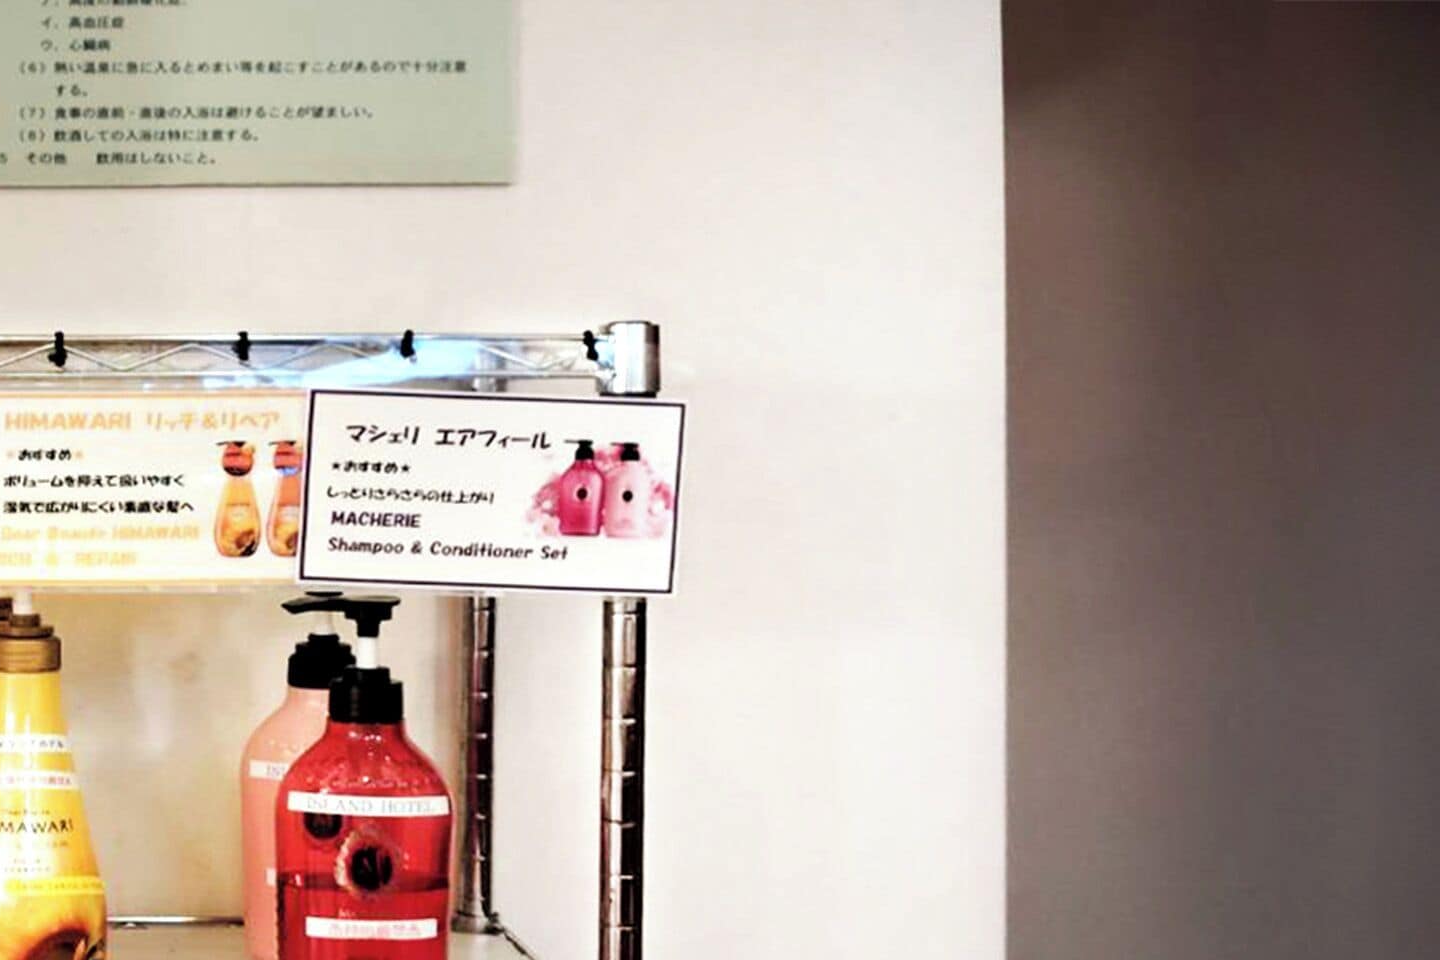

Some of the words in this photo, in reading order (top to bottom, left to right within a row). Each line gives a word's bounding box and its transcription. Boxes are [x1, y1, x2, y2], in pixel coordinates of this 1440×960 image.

[4, 411, 132, 432] HIMAWARI
[346, 424, 421, 446] マシェリ
[434, 427, 552, 450] エアフィール
[330, 510, 423, 529] MACHERIE
[327, 537, 404, 555] Shampoo
[410, 540, 423, 554] &
[429, 541, 534, 559] Conditioner
[540, 545, 569, 560] Set
